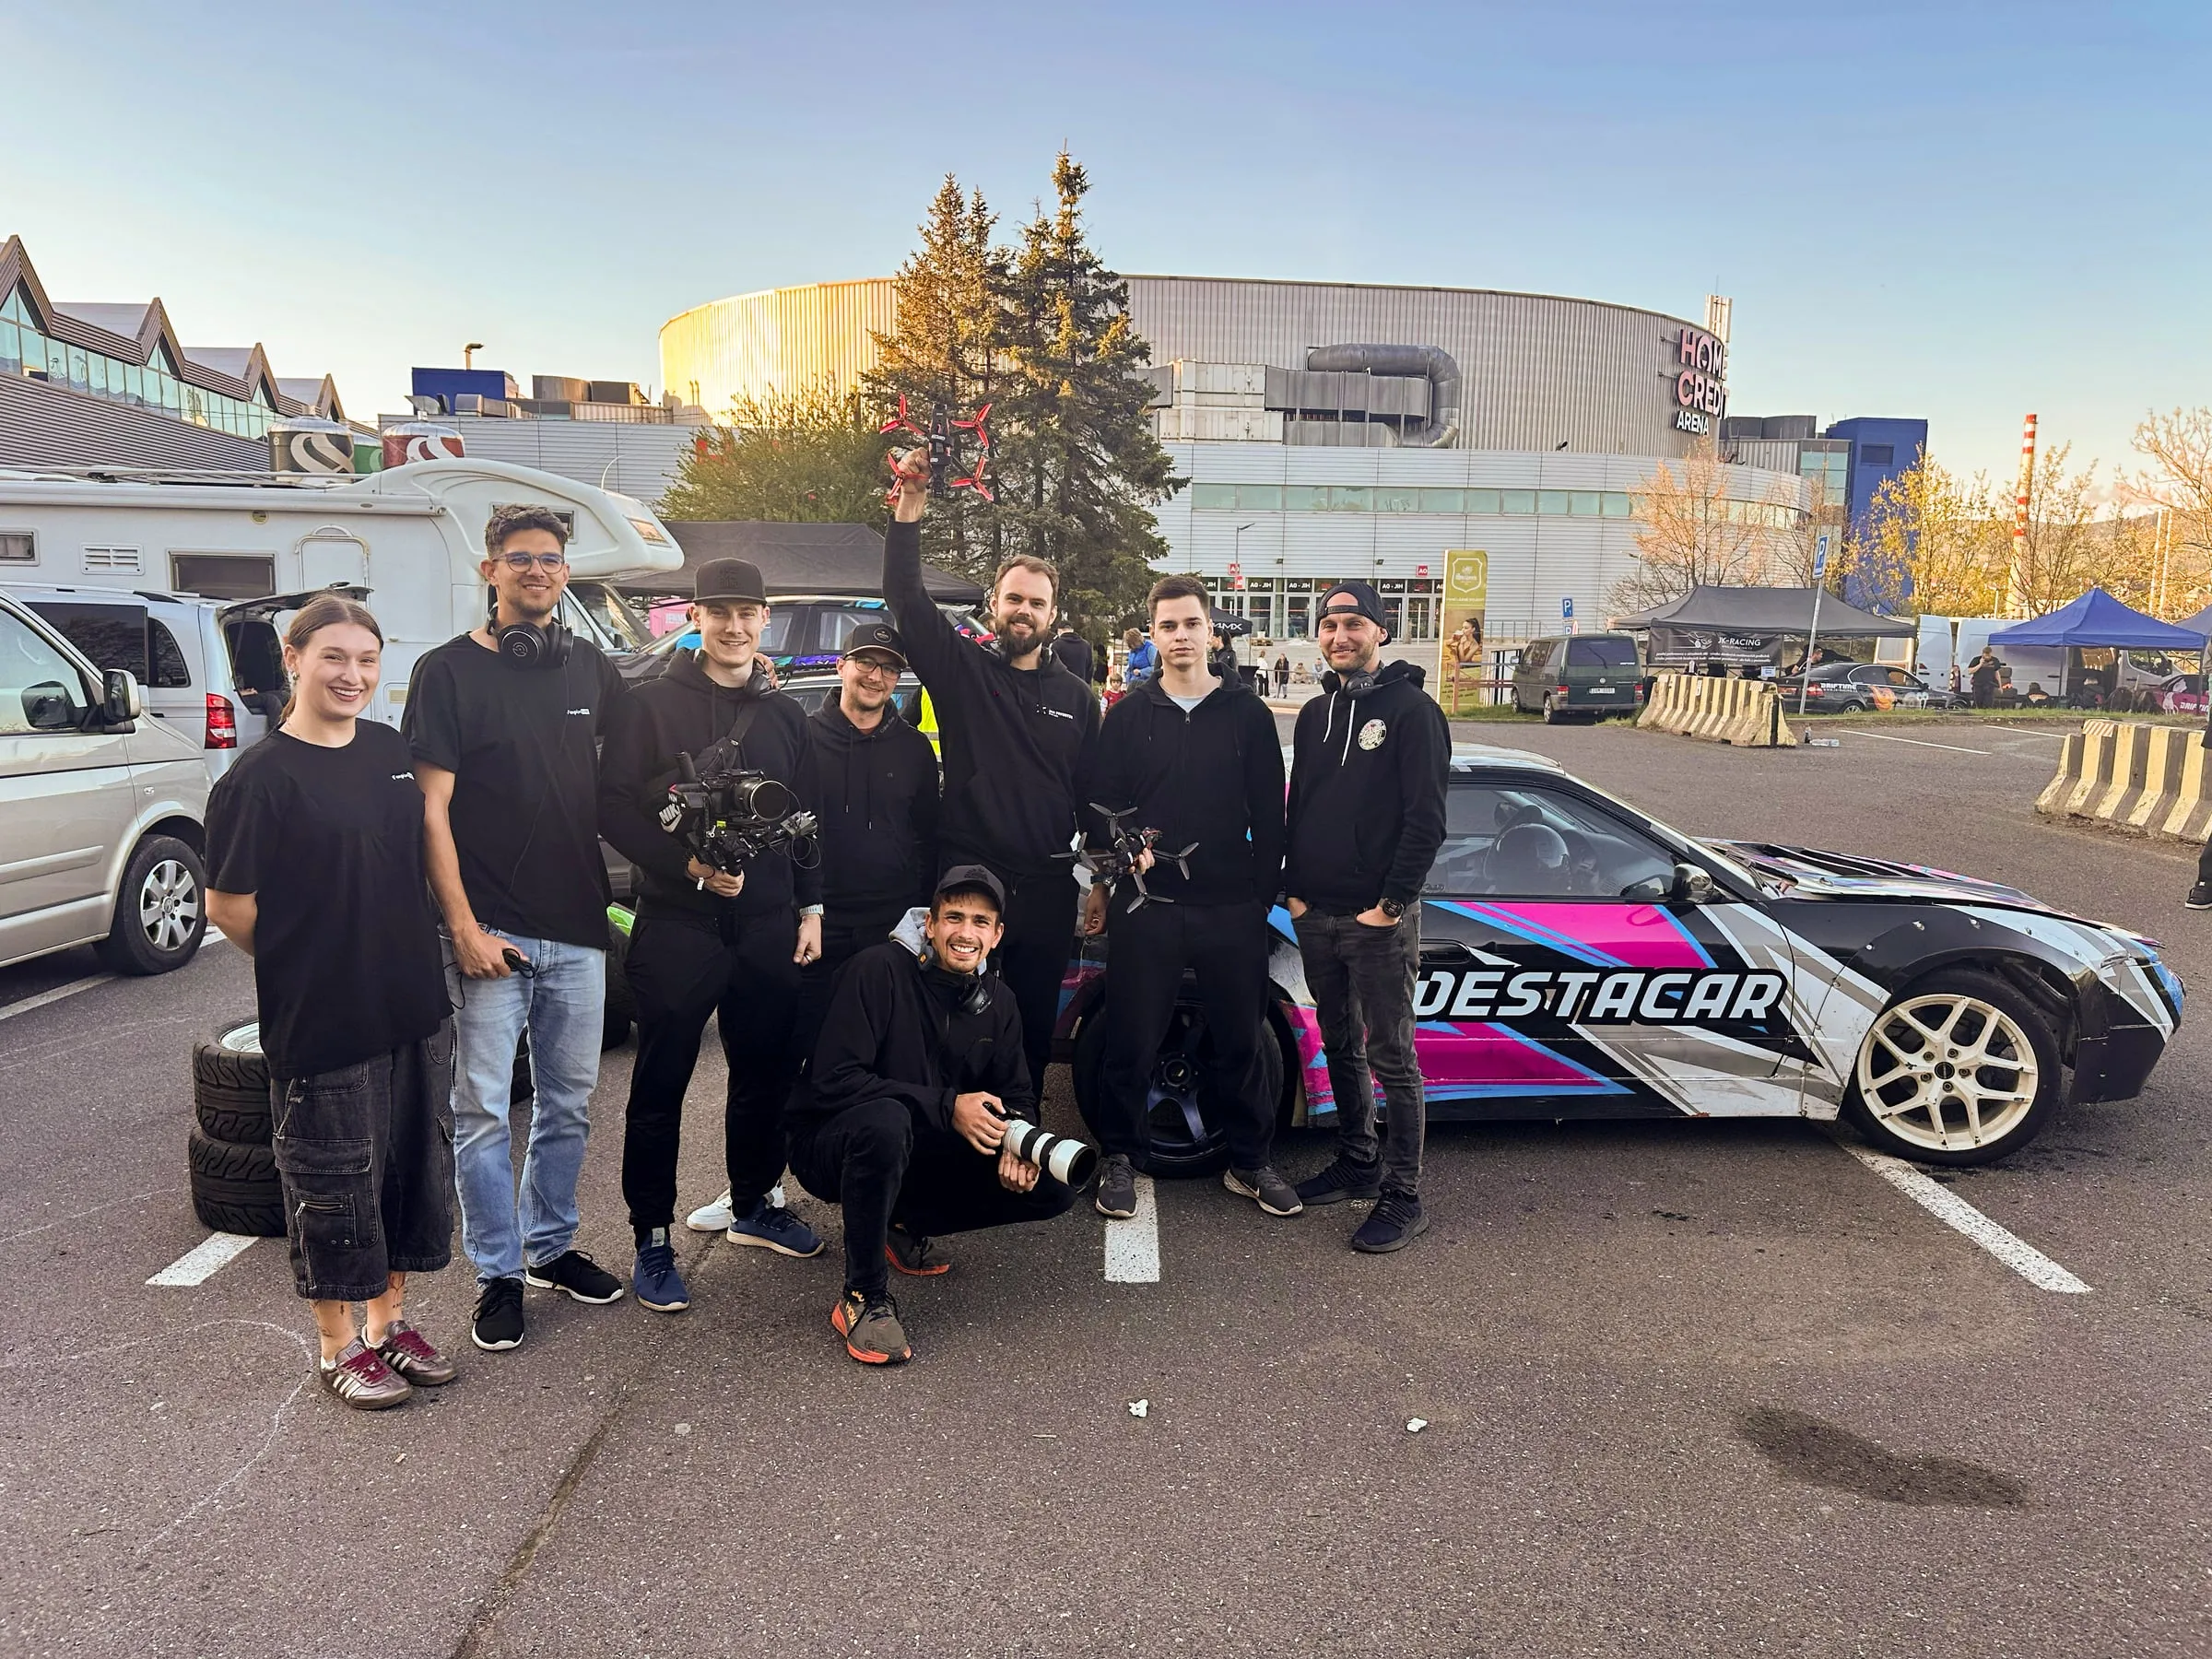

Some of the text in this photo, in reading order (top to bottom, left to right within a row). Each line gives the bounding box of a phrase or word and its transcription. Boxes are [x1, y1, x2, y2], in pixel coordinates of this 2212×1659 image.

[1677, 371, 1729, 420] CREDIT
[1676, 410, 1710, 436] ARENA
[1564, 600, 1571, 612] P
[1718, 637, 1761, 646] JK-RACING
